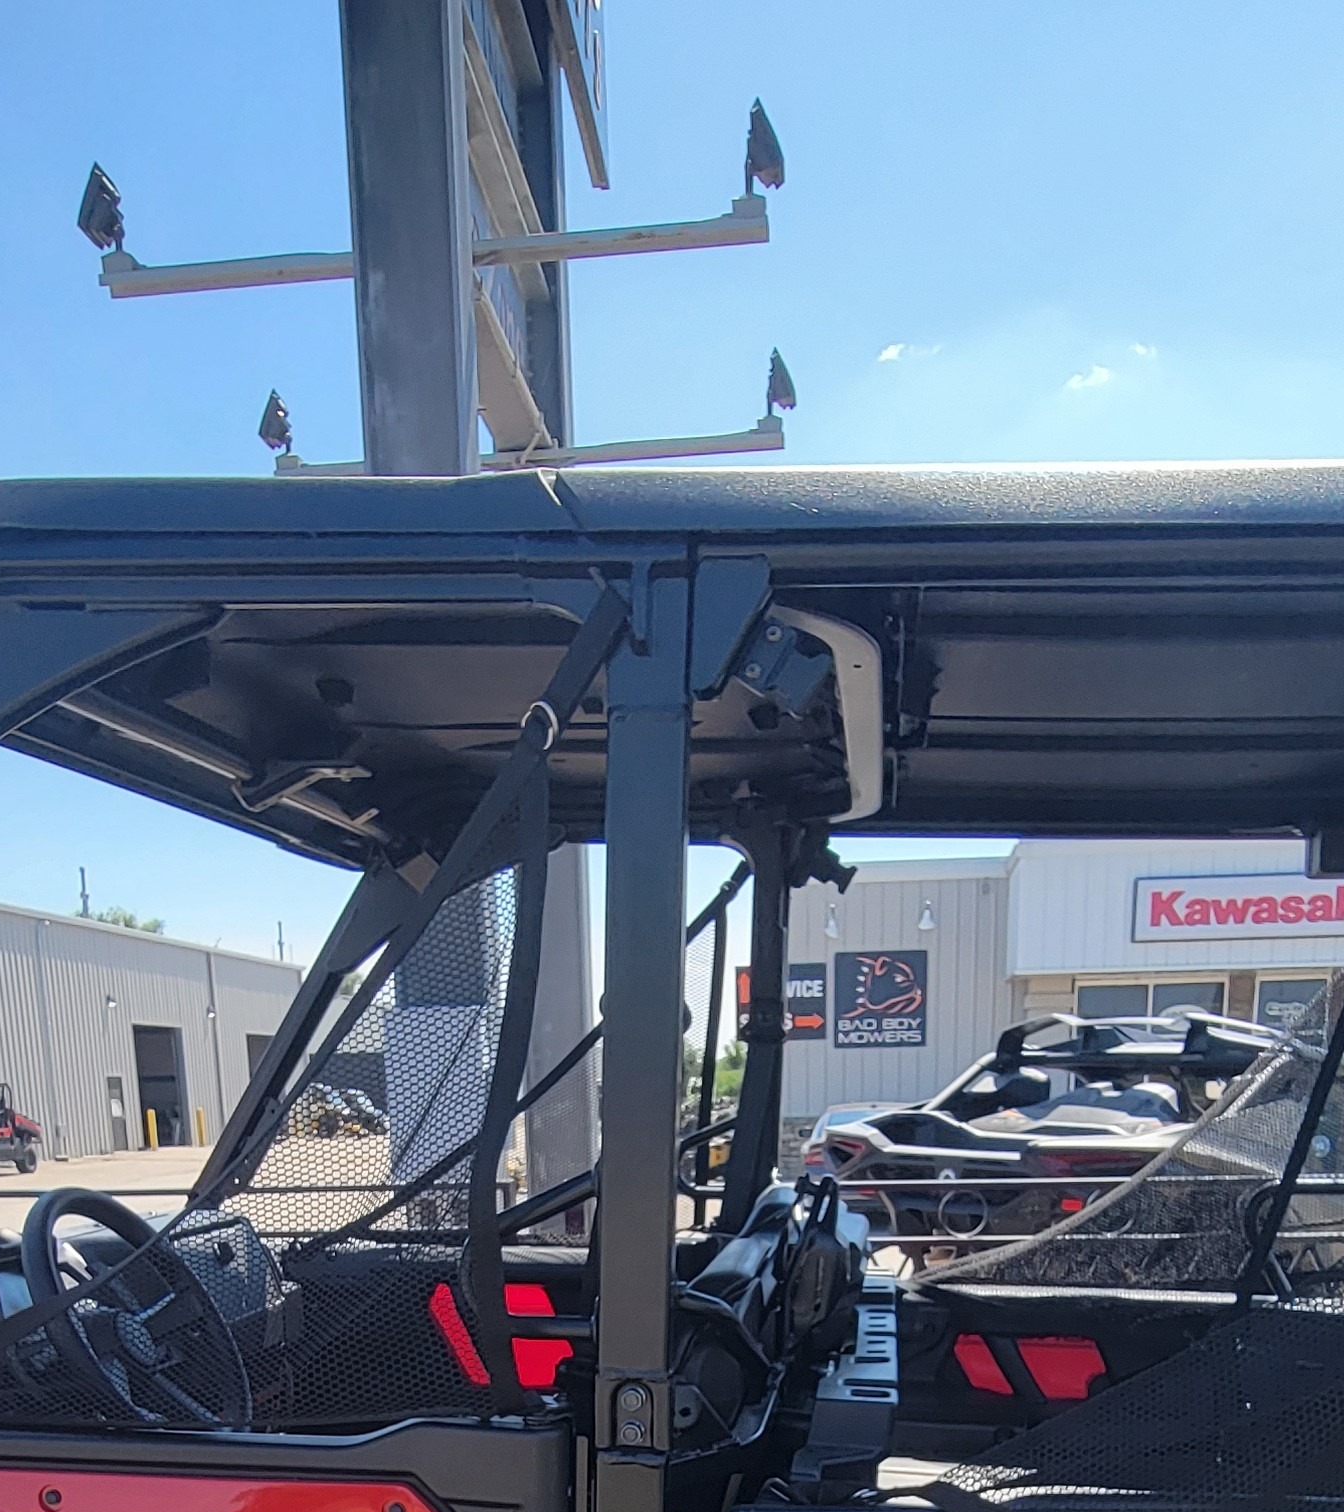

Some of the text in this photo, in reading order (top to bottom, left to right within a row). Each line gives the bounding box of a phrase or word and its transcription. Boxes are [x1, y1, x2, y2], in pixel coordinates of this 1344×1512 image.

[786, 980, 825, 998] VICE
[837, 1017, 922, 1032] BAD BOY
[837, 1030, 922, 1045] MOWERS
